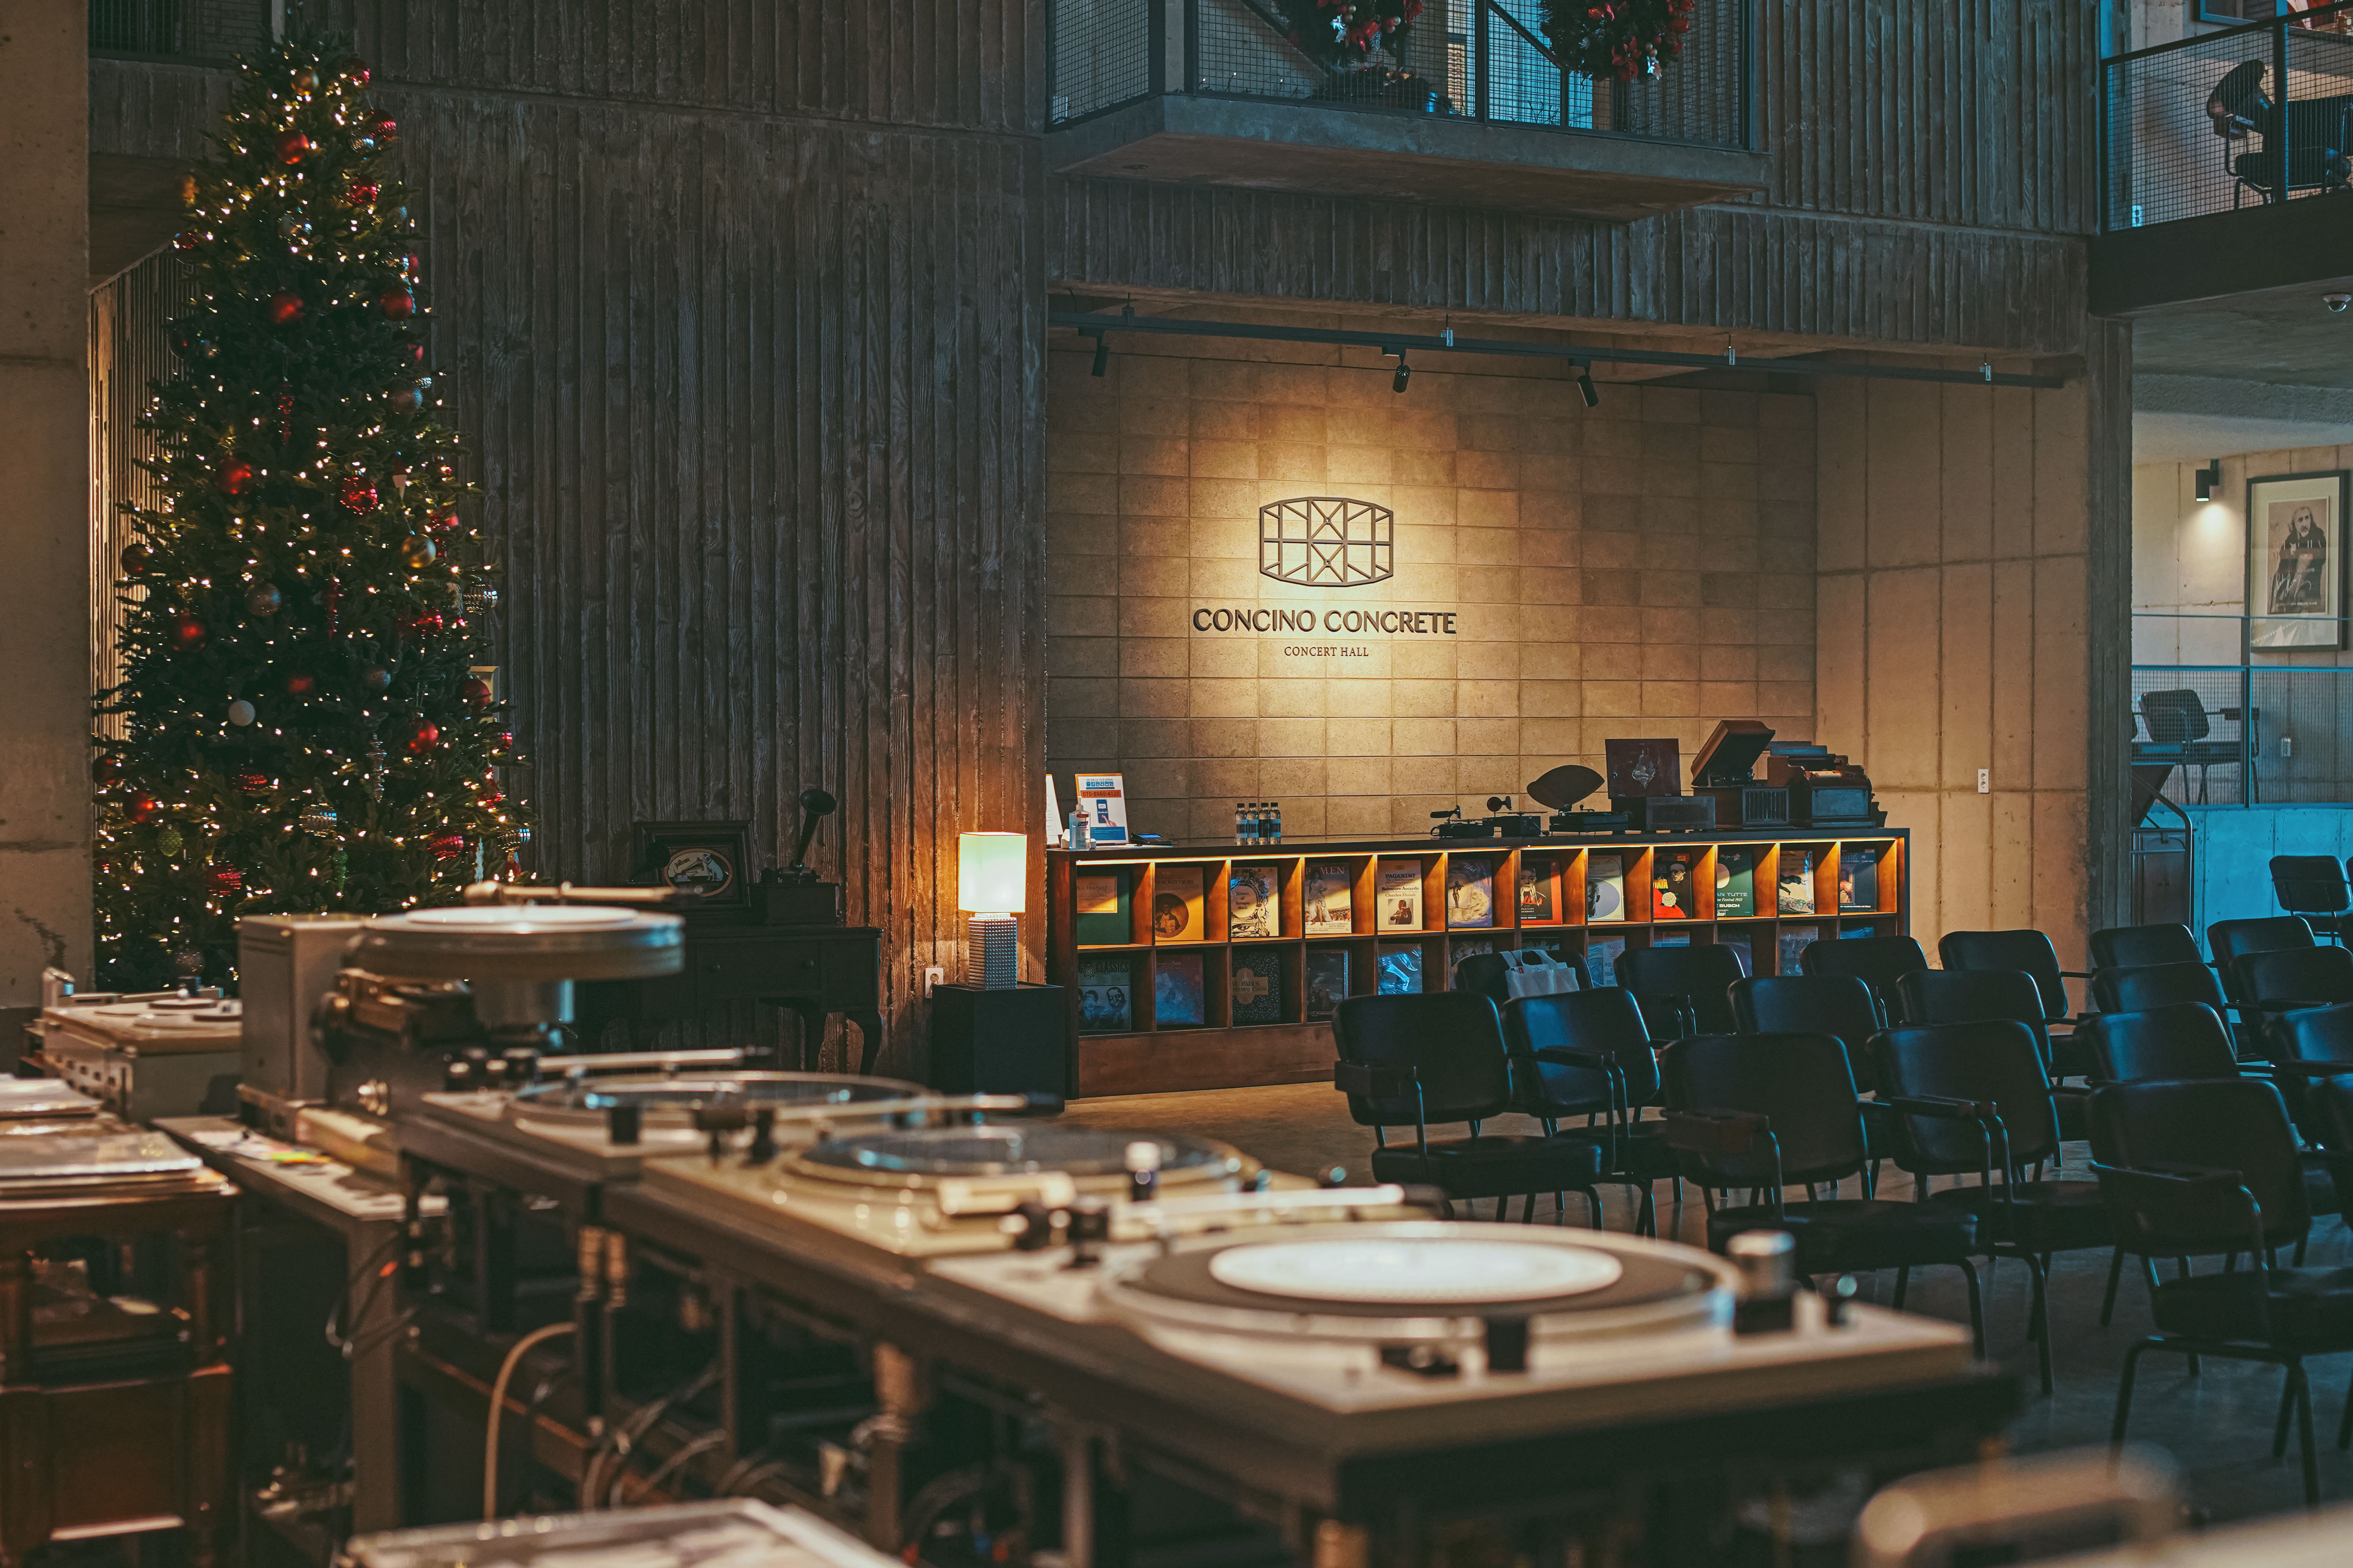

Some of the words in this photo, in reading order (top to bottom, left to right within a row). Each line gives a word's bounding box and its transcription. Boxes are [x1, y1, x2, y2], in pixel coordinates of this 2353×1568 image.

[1193, 609, 1316, 632] CONCINO
[1324, 610, 1457, 634] CONCRETE
[1284, 647, 1337, 656] CONCERT
[1341, 647, 1369, 656] HALL
[1096, 962, 1129, 973] CLASSICS
